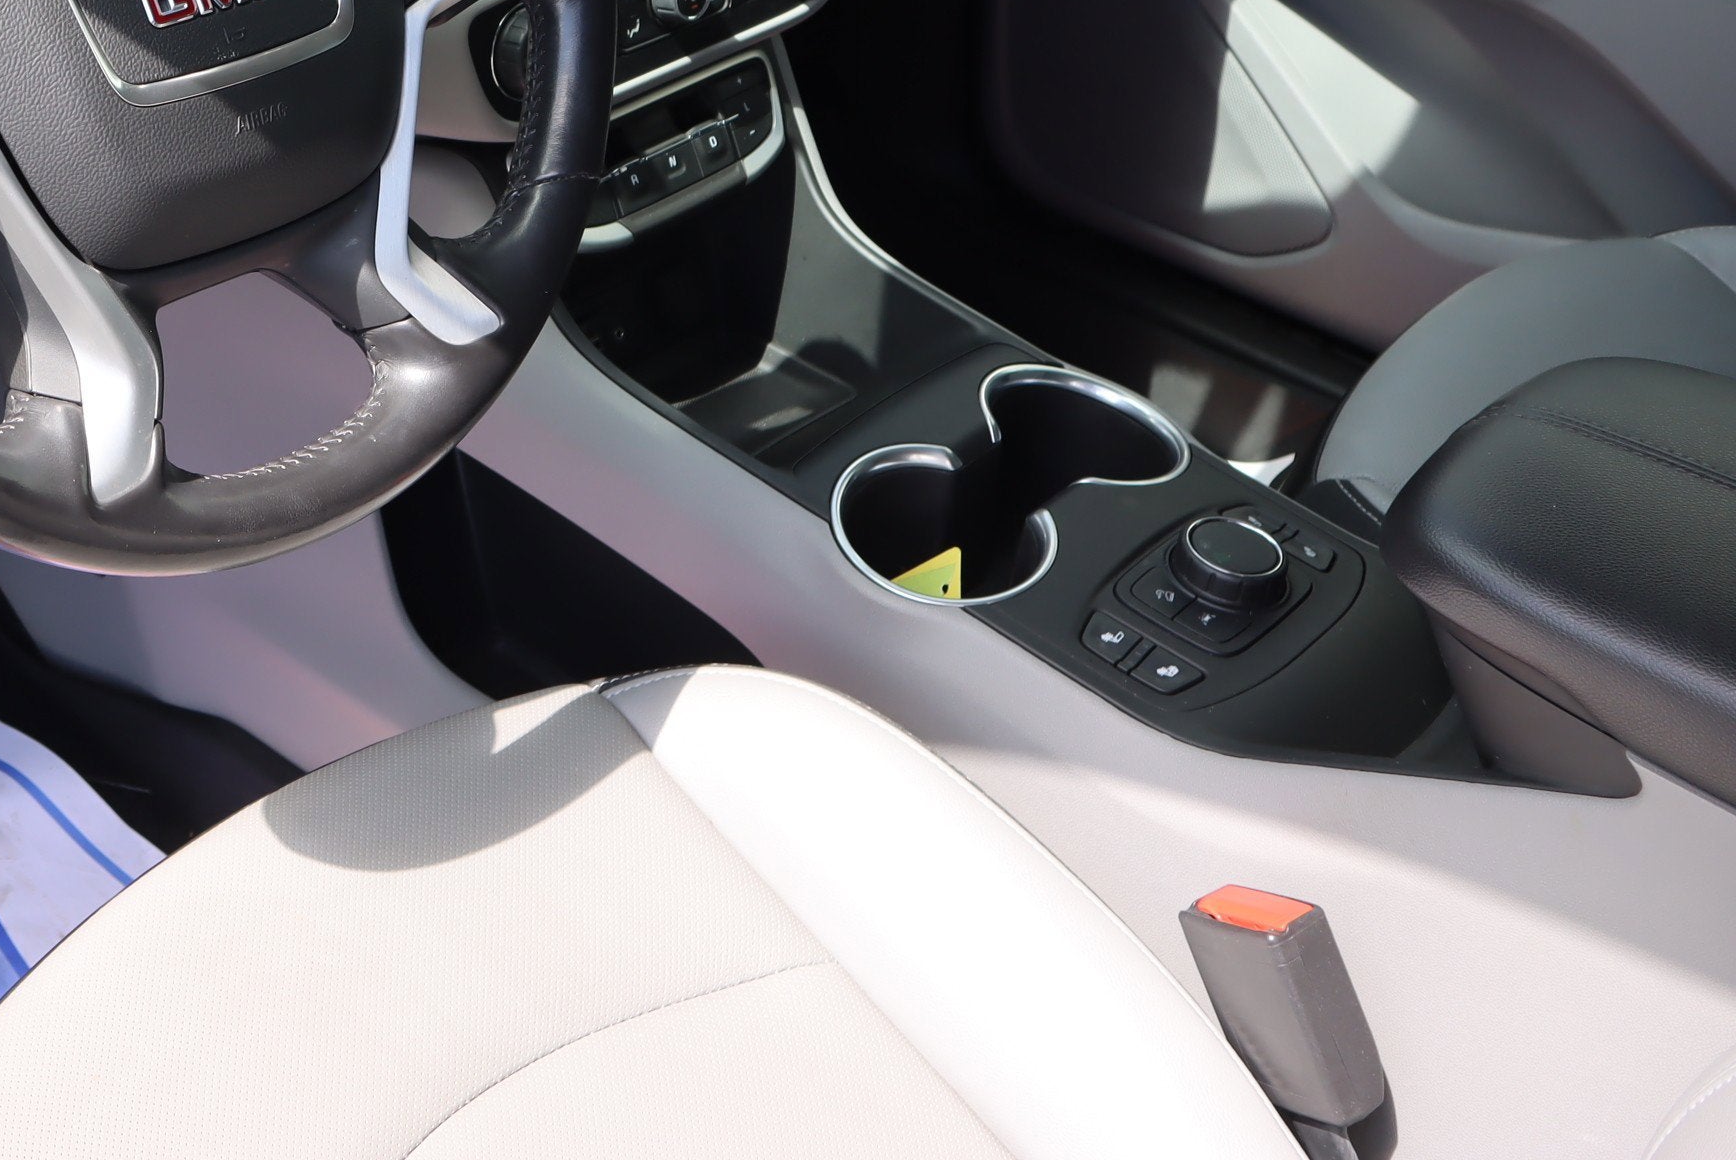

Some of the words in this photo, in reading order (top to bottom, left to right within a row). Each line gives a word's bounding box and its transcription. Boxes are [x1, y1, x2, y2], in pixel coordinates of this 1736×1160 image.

[235, 102, 288, 136] AIRBAG
[708, 135, 718, 148] D
[668, 155, 677, 168] N
[630, 173, 640, 186] R
